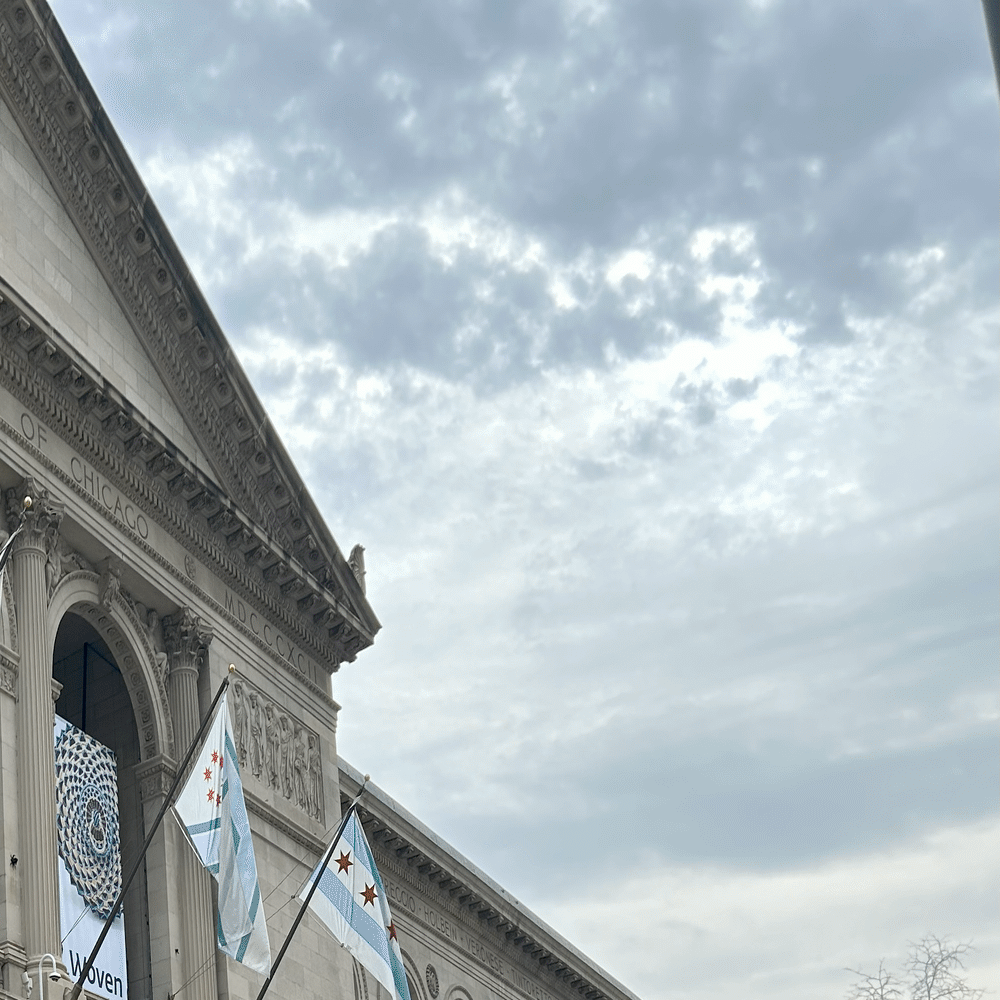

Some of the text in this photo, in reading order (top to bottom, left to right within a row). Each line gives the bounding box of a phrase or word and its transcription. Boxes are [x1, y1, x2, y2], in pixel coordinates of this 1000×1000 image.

[20, 412, 48, 450] OF
[70, 456, 149, 540] CHICAGO
[68, 949, 123, 998] Woven
